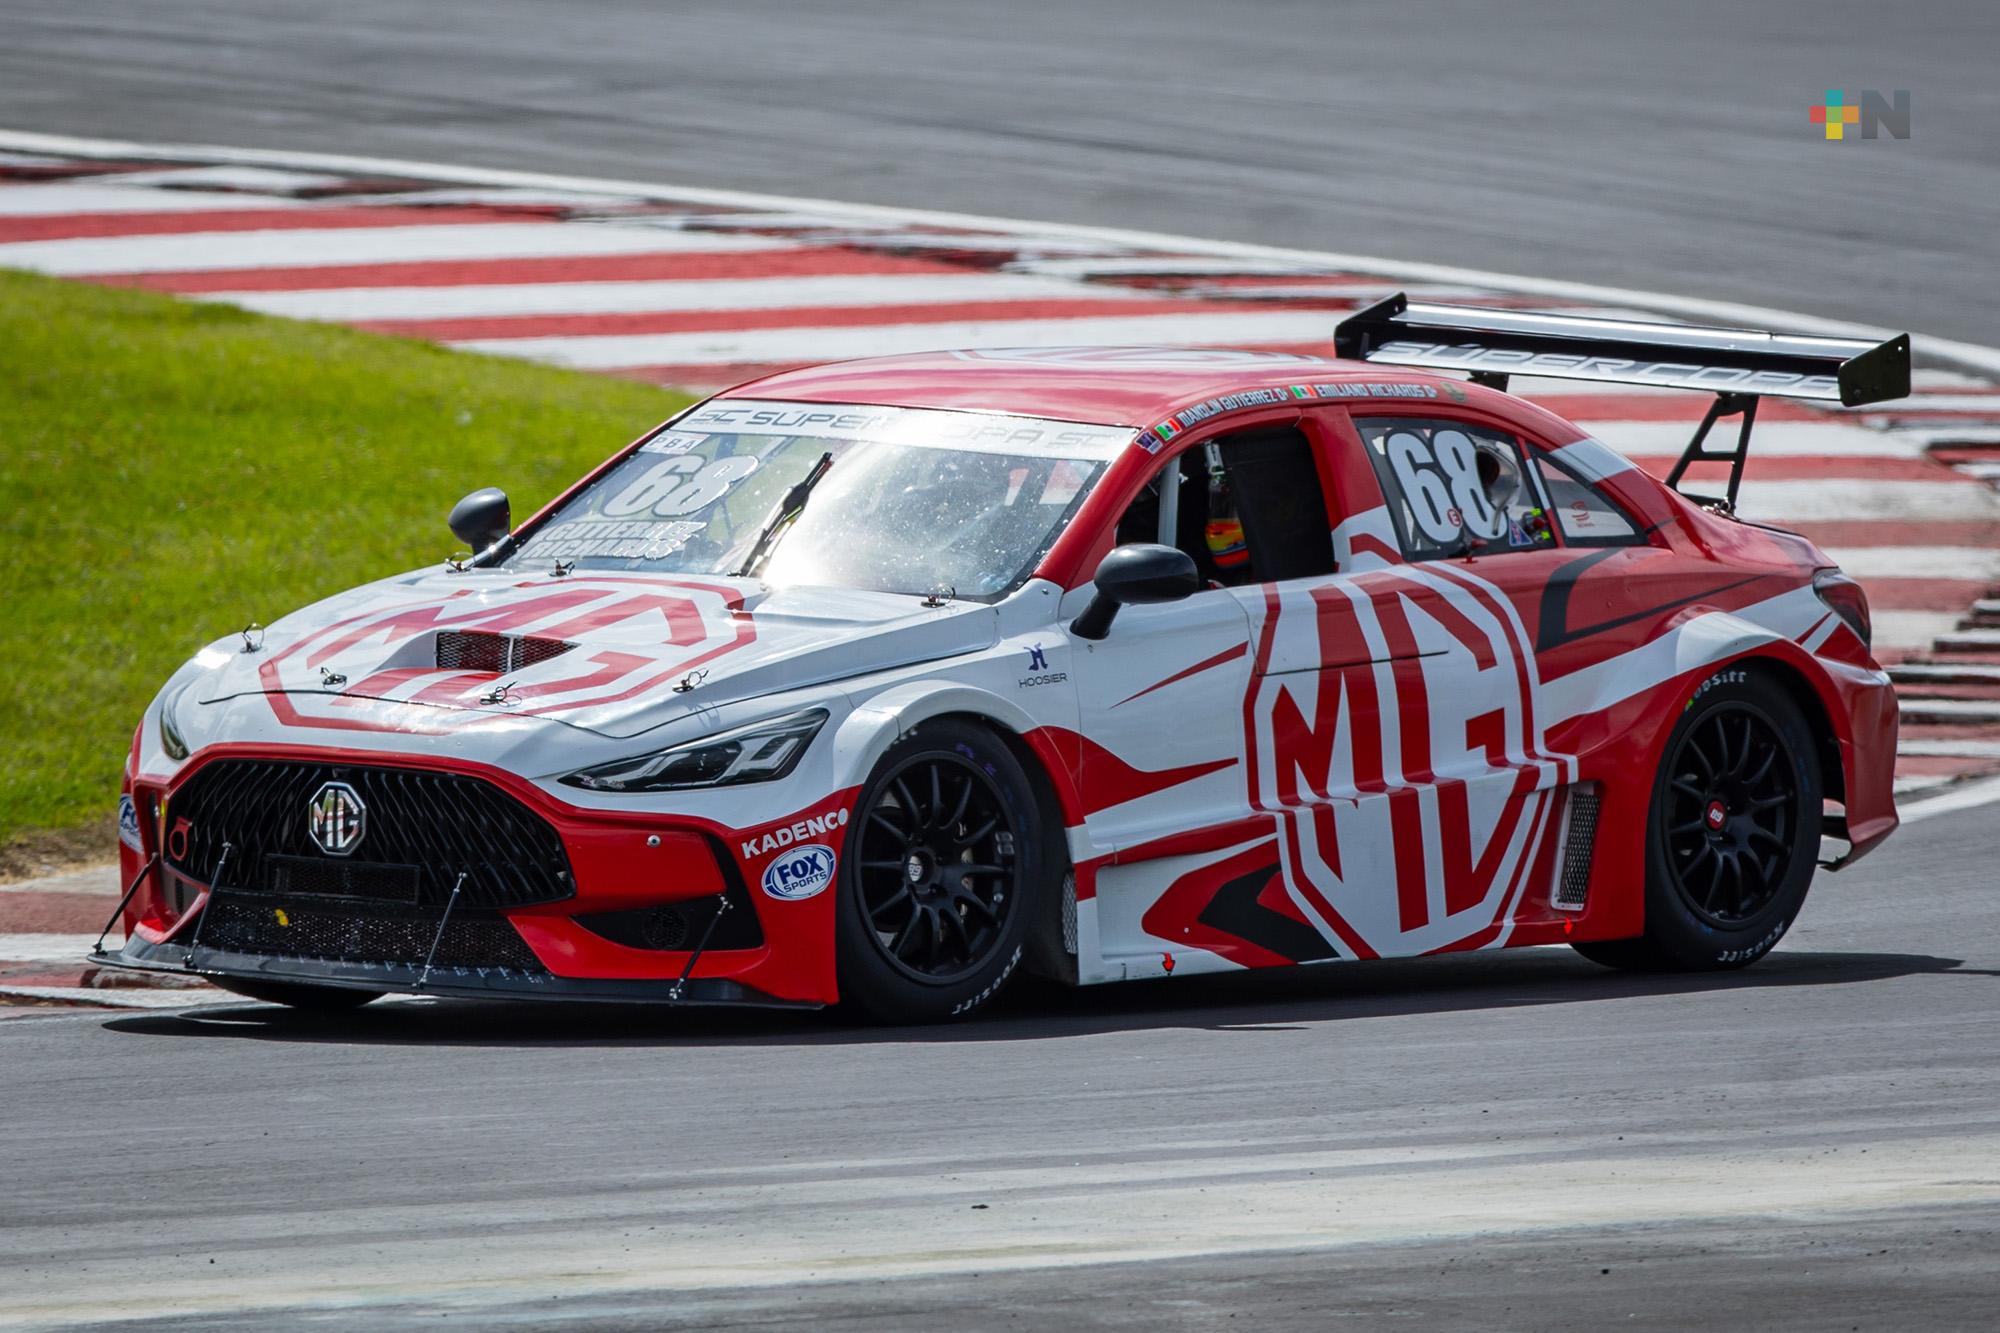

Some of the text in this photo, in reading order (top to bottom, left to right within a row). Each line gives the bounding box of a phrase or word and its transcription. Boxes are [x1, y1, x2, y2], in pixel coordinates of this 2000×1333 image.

[692, 409, 752, 423] SC
[601, 454, 758, 518] 68
[1386, 430, 1508, 543] 68
[1018, 672, 1068, 688] HOOSIER
[312, 788, 360, 849] MG
[741, 808, 848, 859] KADENCO
[777, 853, 824, 885] FOX
[784, 871, 827, 893] SPORTS
